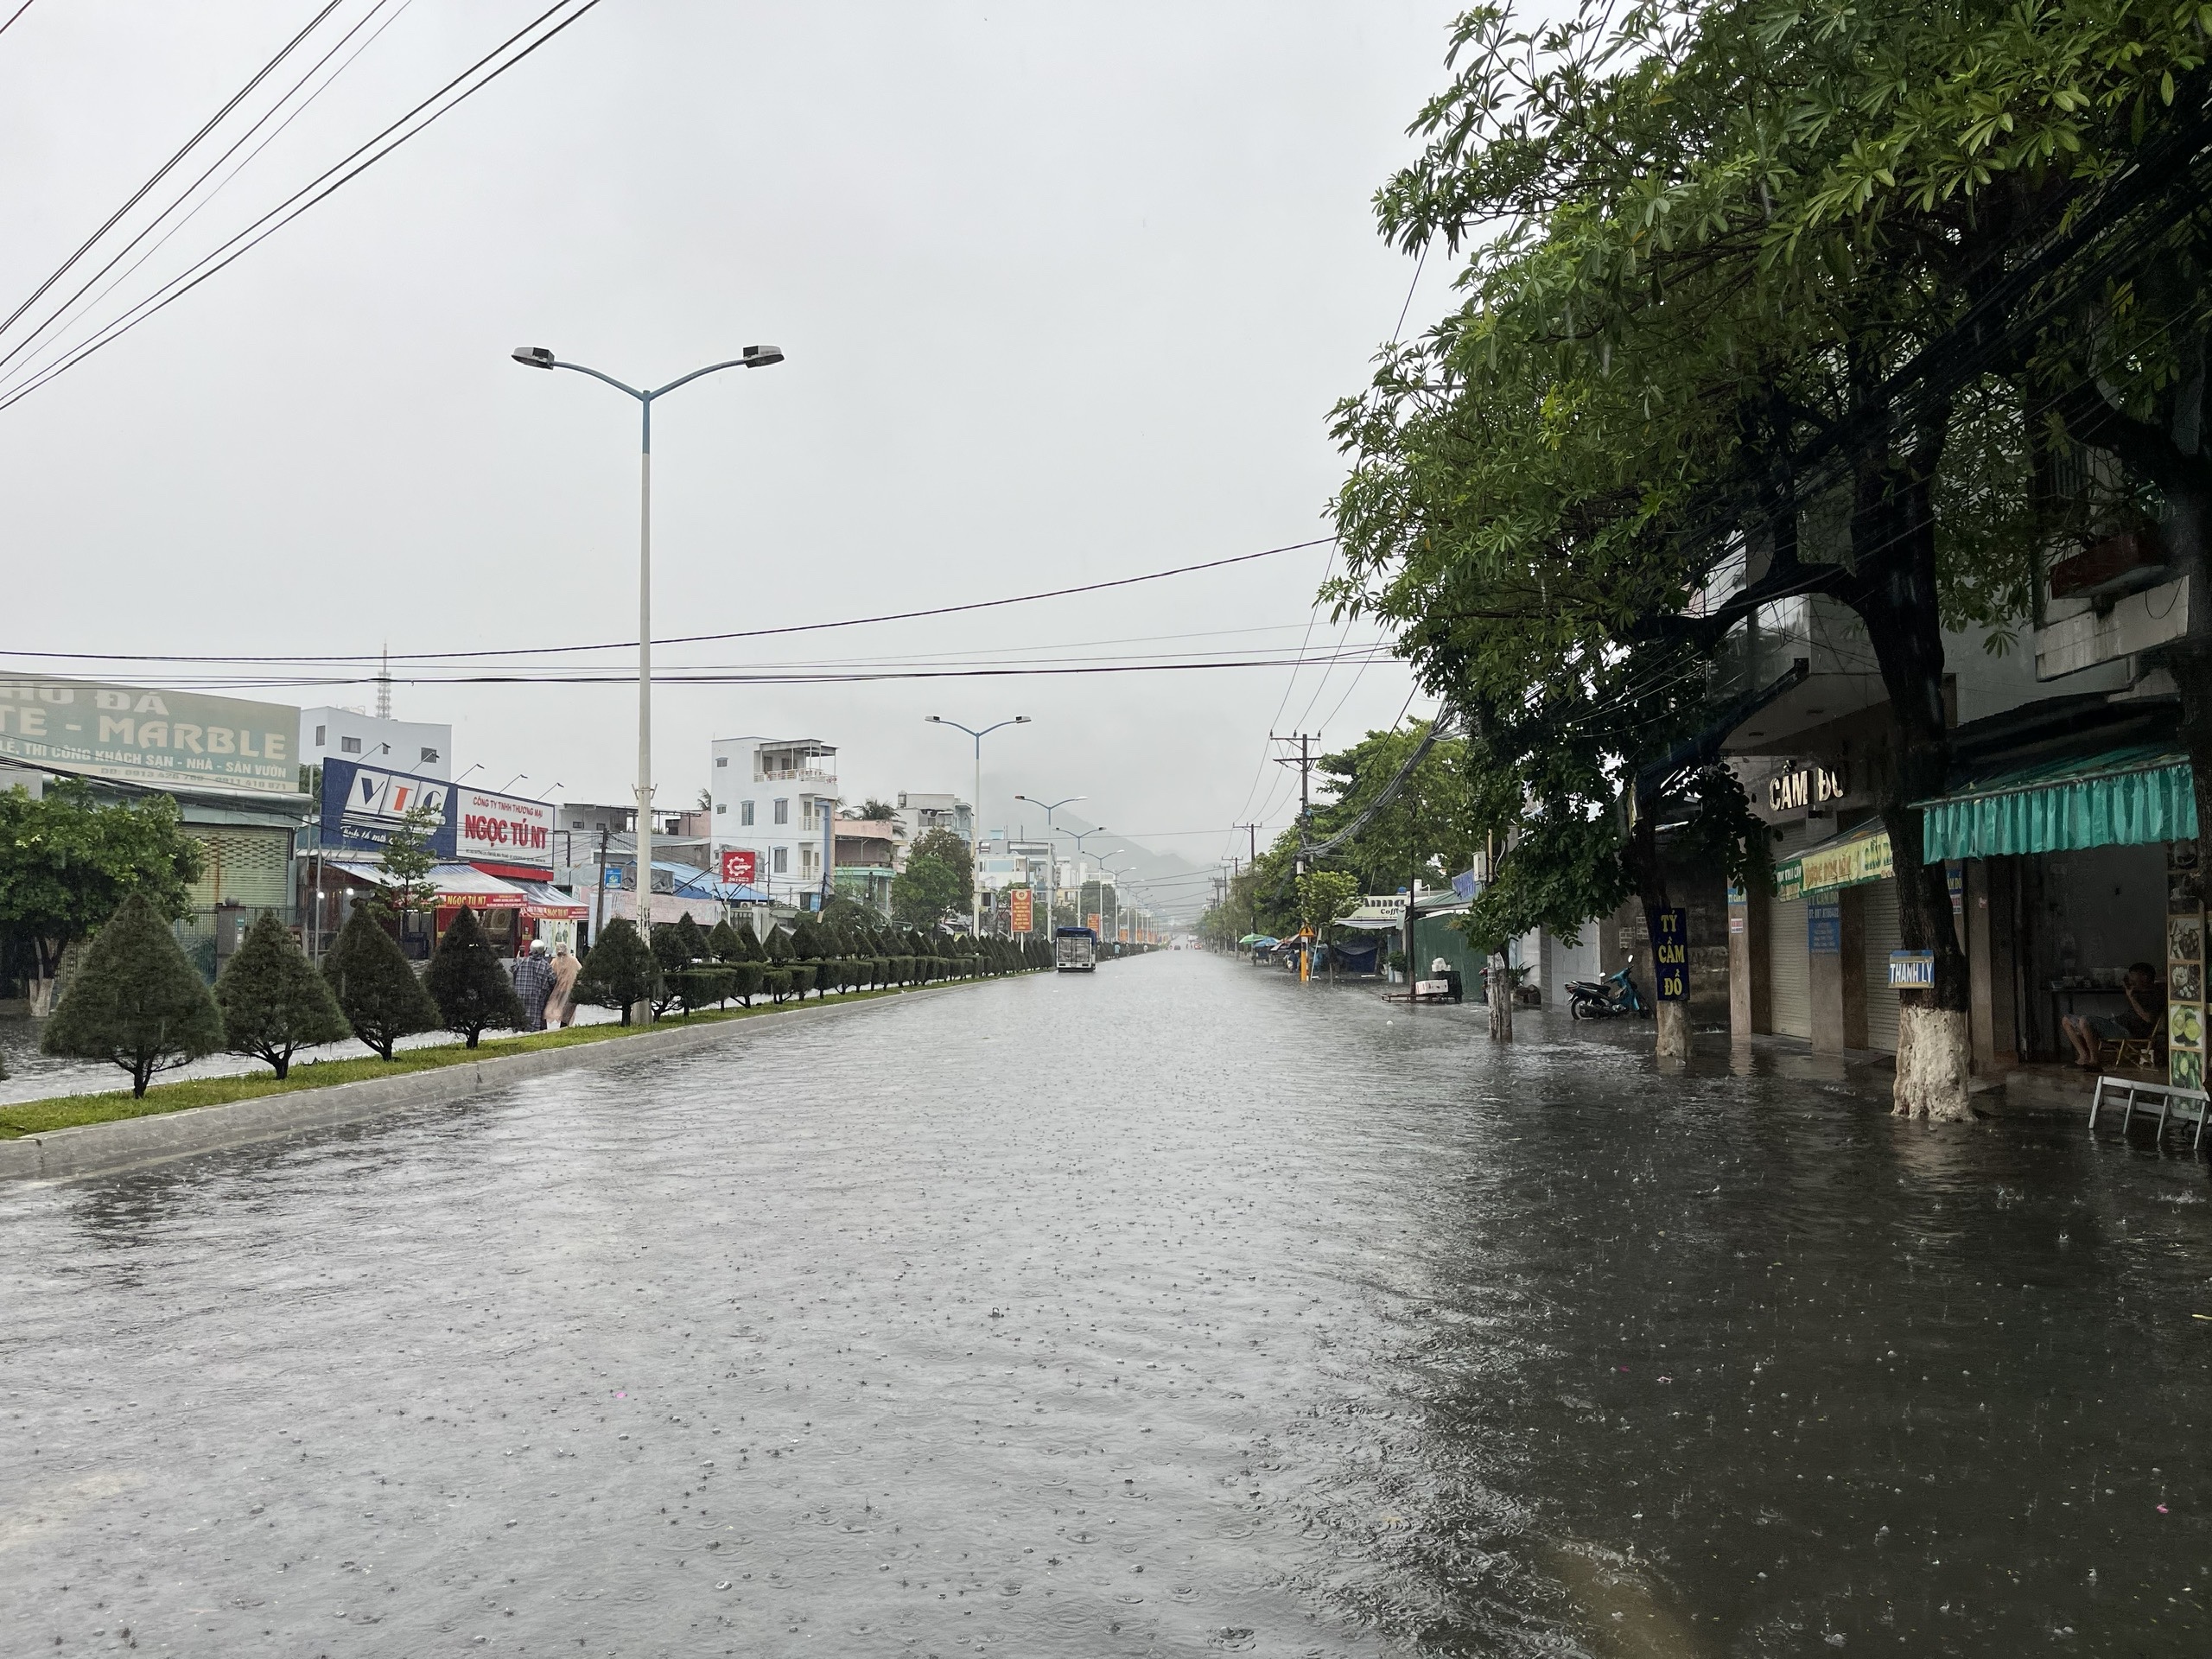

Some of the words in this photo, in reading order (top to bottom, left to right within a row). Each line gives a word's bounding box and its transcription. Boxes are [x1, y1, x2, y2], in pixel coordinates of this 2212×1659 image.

[94, 690, 169, 715] ĐÁ
[99, 715, 286, 760] MARBLE
[24, 743, 47, 756] THI
[52, 744, 91, 760] CÔNG
[95, 750, 142, 765] KHÁCH
[146, 754, 173, 769] SẠN
[187, 757, 213, 770] NHÀ
[226, 760, 251, 774] SÂN
[255, 763, 286, 778] VƯỜN
[473, 796, 489, 807] CÔNG
[490, 800, 497, 809] TY
[498, 802, 512, 812] TNHH
[512, 804, 534, 816] THƯƠNG
[534, 808, 543, 819] MẠI
[464, 814, 508, 847] NGỌC
[511, 818, 529, 846] TÚ
[531, 826, 549, 849] NT
[1661, 909, 1677, 932] TÝ
[1658, 936, 1685, 963] CẦM
[1663, 969, 1682, 995] ĐỒ
[1890, 963, 1918, 983] THANH
